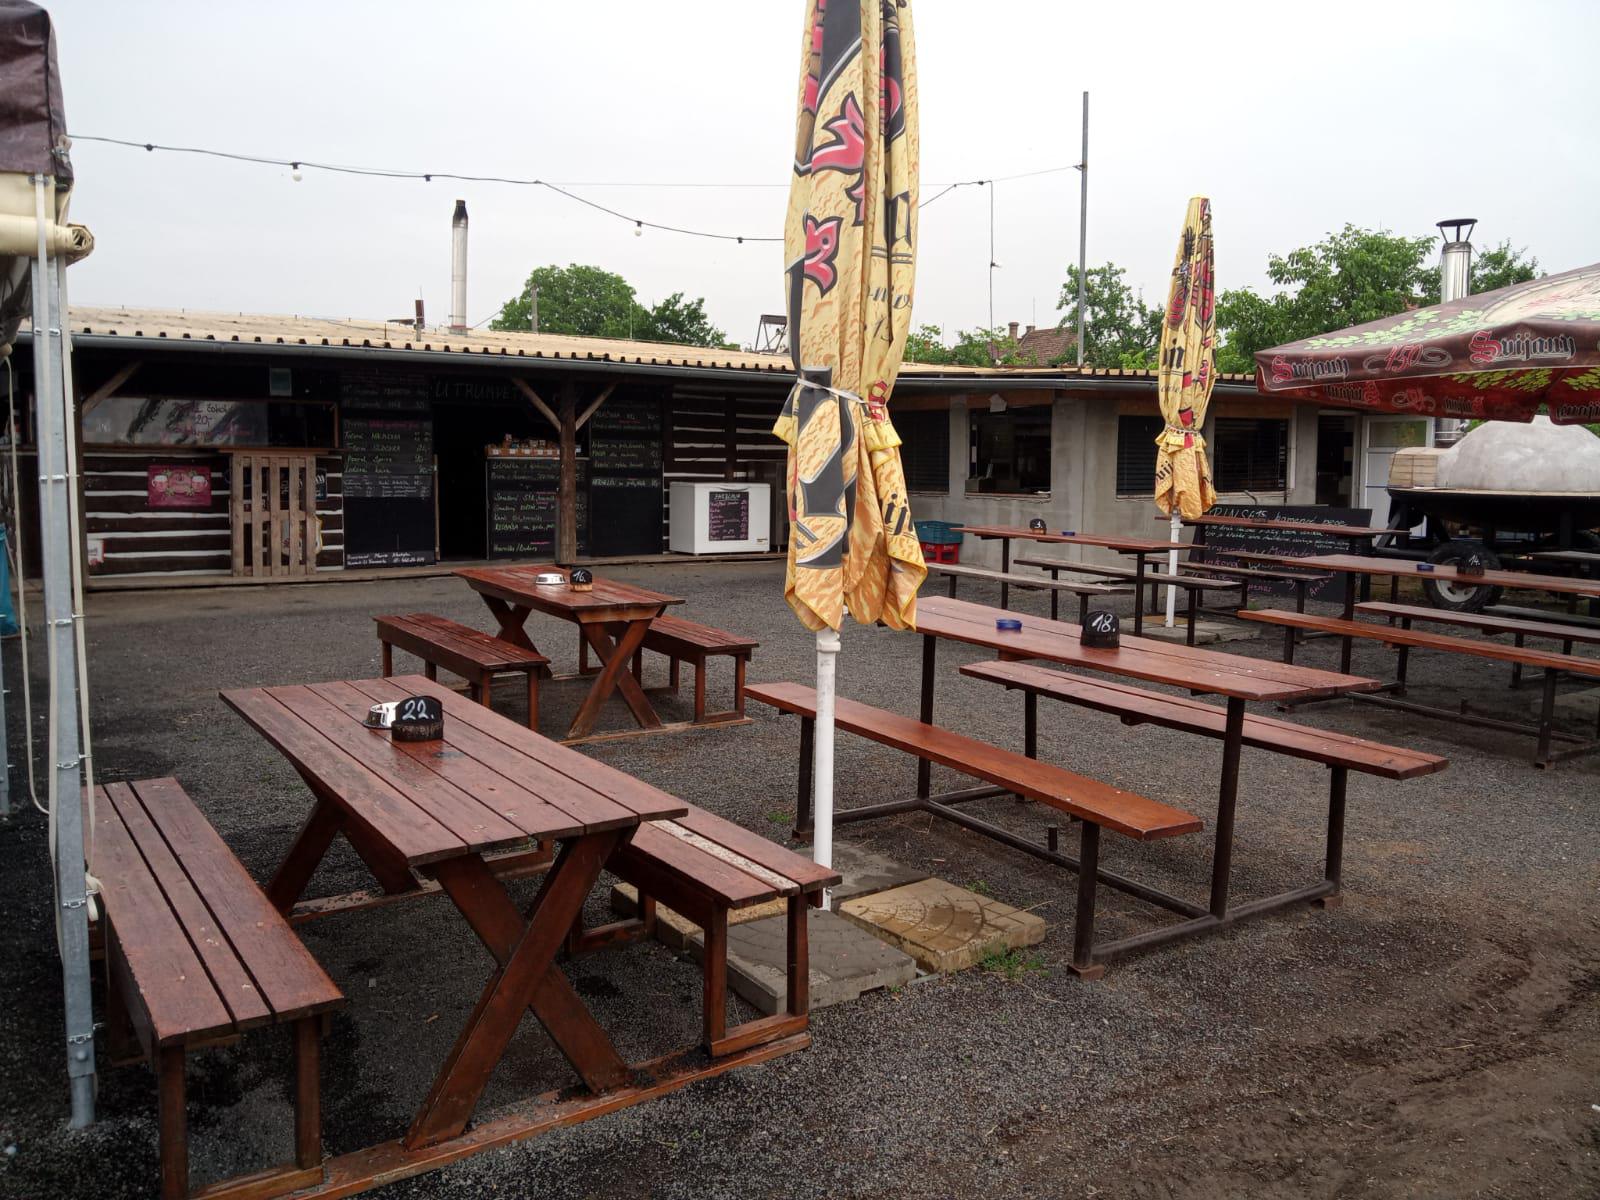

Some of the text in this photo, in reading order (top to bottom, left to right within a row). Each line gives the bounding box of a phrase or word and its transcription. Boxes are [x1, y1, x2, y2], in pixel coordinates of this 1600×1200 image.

[1469, 331, 1576, 362] Svijany
[1272, 355, 1349, 384] Svijany
[1092, 614, 1116, 633] 18.
[402, 699, 434, 721] 22.
